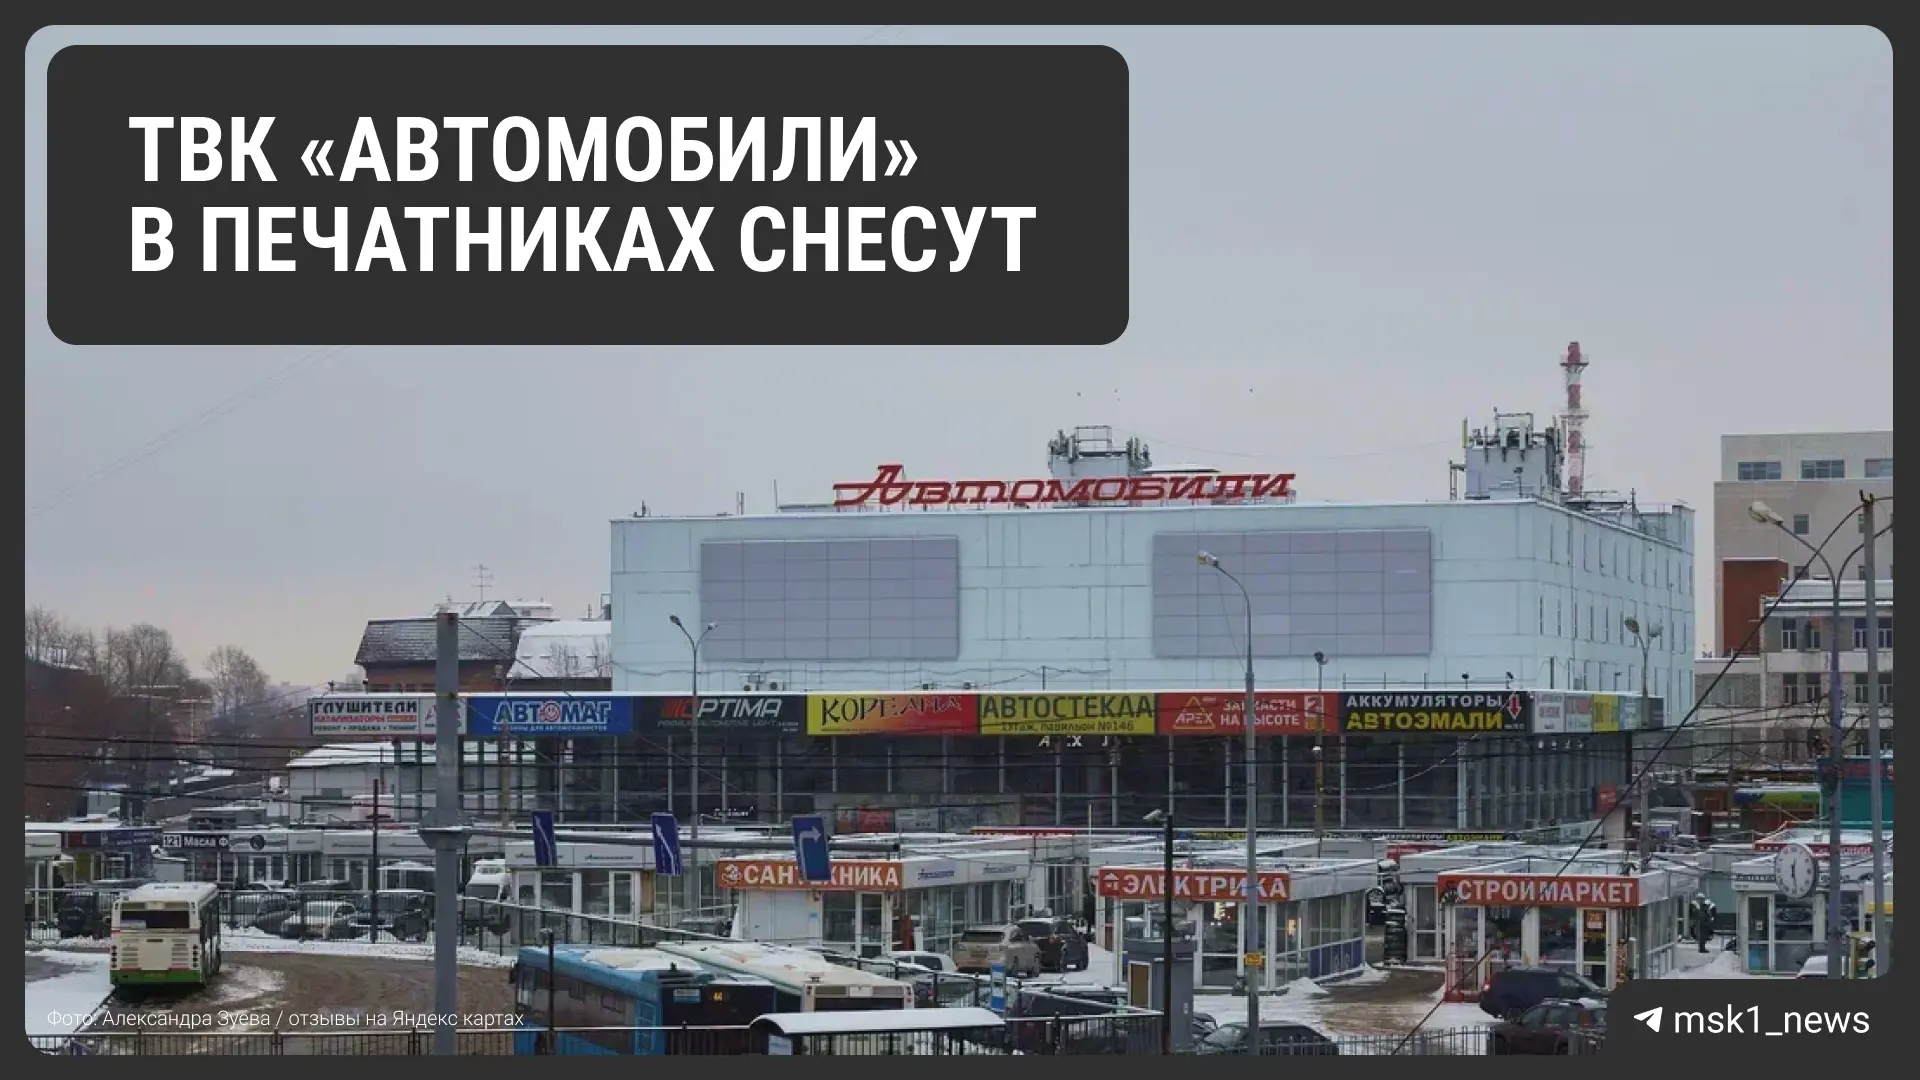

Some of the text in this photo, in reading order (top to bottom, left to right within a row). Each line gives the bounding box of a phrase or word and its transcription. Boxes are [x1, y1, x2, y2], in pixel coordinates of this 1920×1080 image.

[314, 701, 417, 713] ГЛУШИТЕЛИ
[670, 699, 782, 717] OPTIMA
[983, 695, 1152, 719] АВТОСТЕКЛА
[1346, 695, 1501, 707] АККУМУЛЯТОРЫ
[494, 700, 611, 724] АВТОМАГ
[1175, 713, 1213, 724] APEX
[1040, 722, 1095, 732] павильон
[1220, 714, 1240, 726] НА
[1346, 711, 1502, 730] АВТОЭМАЛИ
[744, 864, 899, 887] САНХНИКА
